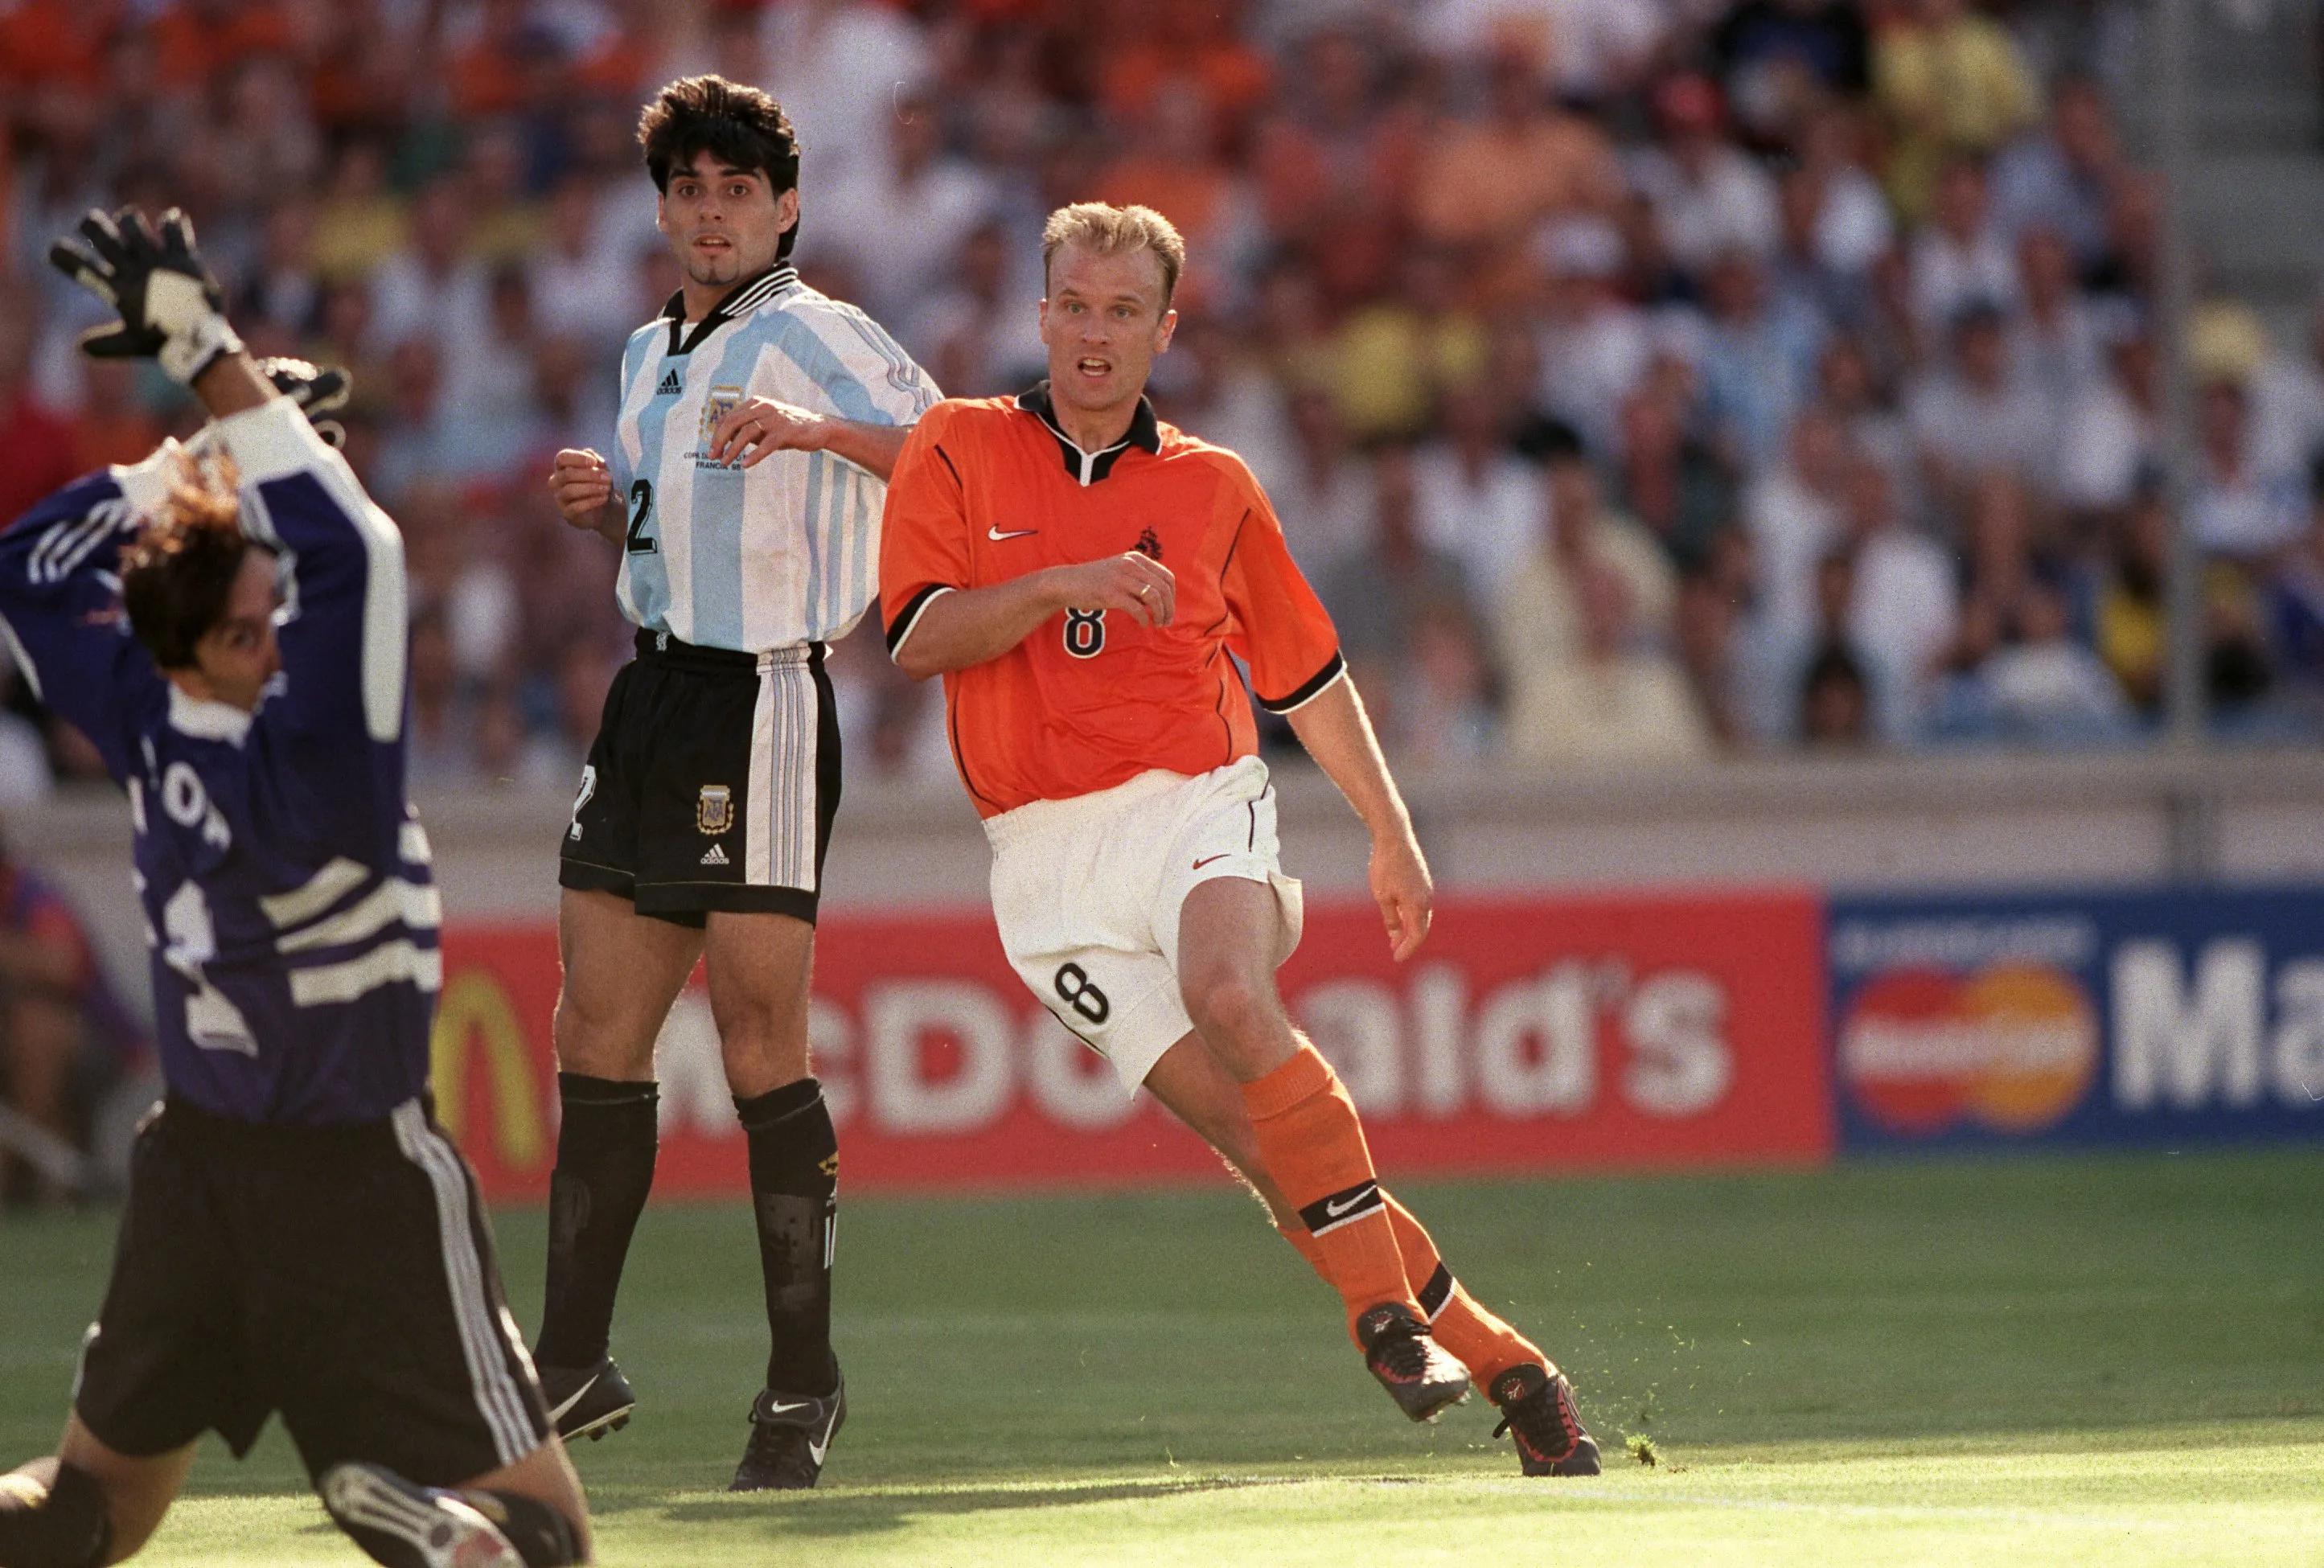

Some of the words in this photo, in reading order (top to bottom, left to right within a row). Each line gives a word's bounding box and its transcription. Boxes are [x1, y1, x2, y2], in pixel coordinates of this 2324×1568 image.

[627, 478, 657, 555] 2
[1064, 606, 1106, 659] 8
[700, 856, 730, 865] adidas
[1055, 963, 1109, 1022] 8
[550, 957, 1739, 1138] Doald's
